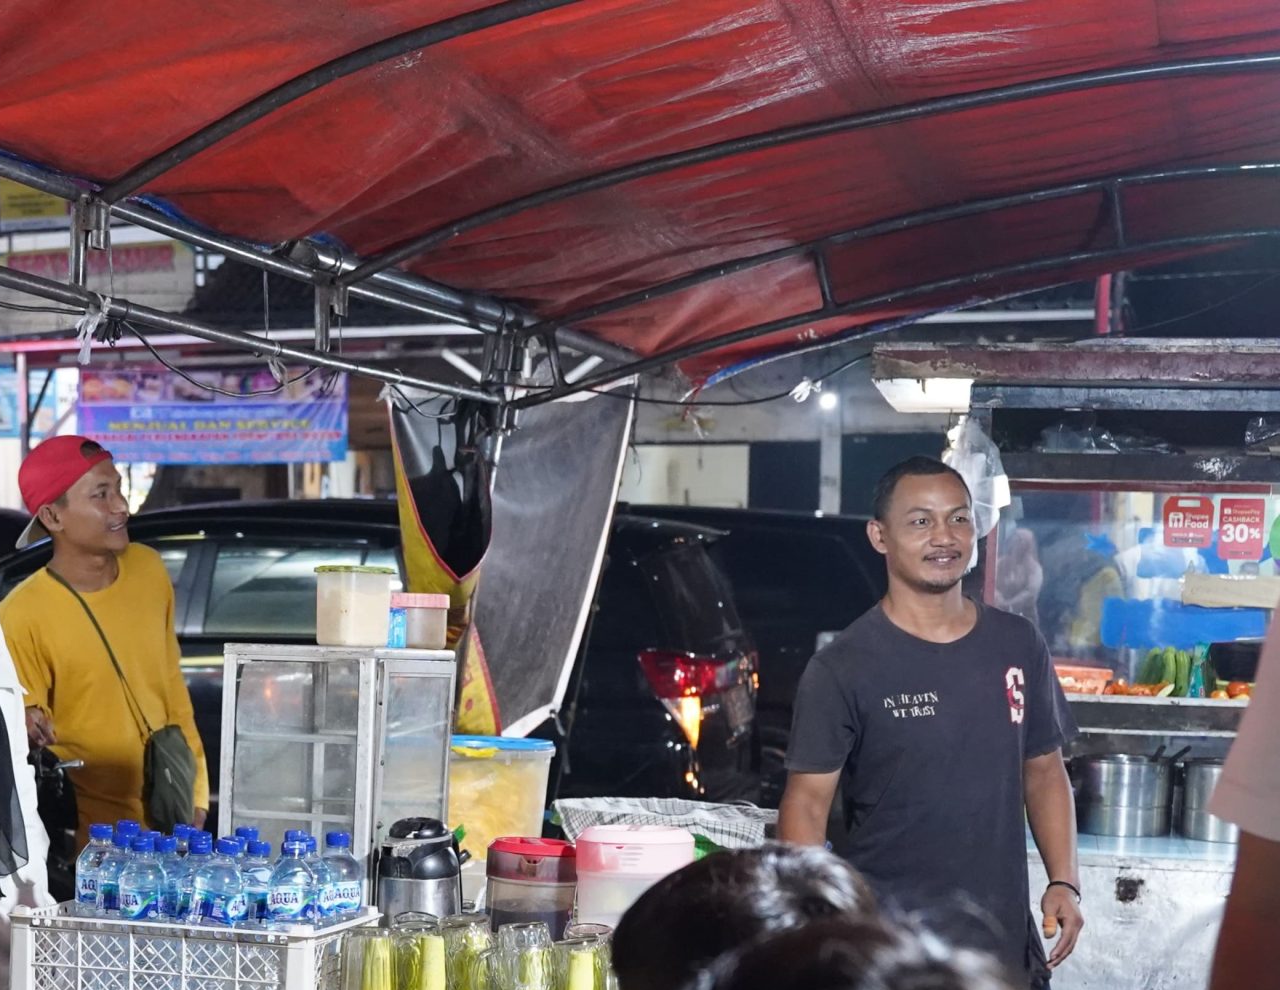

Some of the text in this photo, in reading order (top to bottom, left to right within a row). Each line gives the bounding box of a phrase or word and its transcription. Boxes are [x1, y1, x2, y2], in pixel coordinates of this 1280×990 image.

[1184, 520, 1209, 529] Food
[1221, 523, 1261, 543] 30%
[898, 691, 939, 705] HEAVEN
[910, 705, 936, 718] TRUST
[270, 892, 298, 906] AQUA
